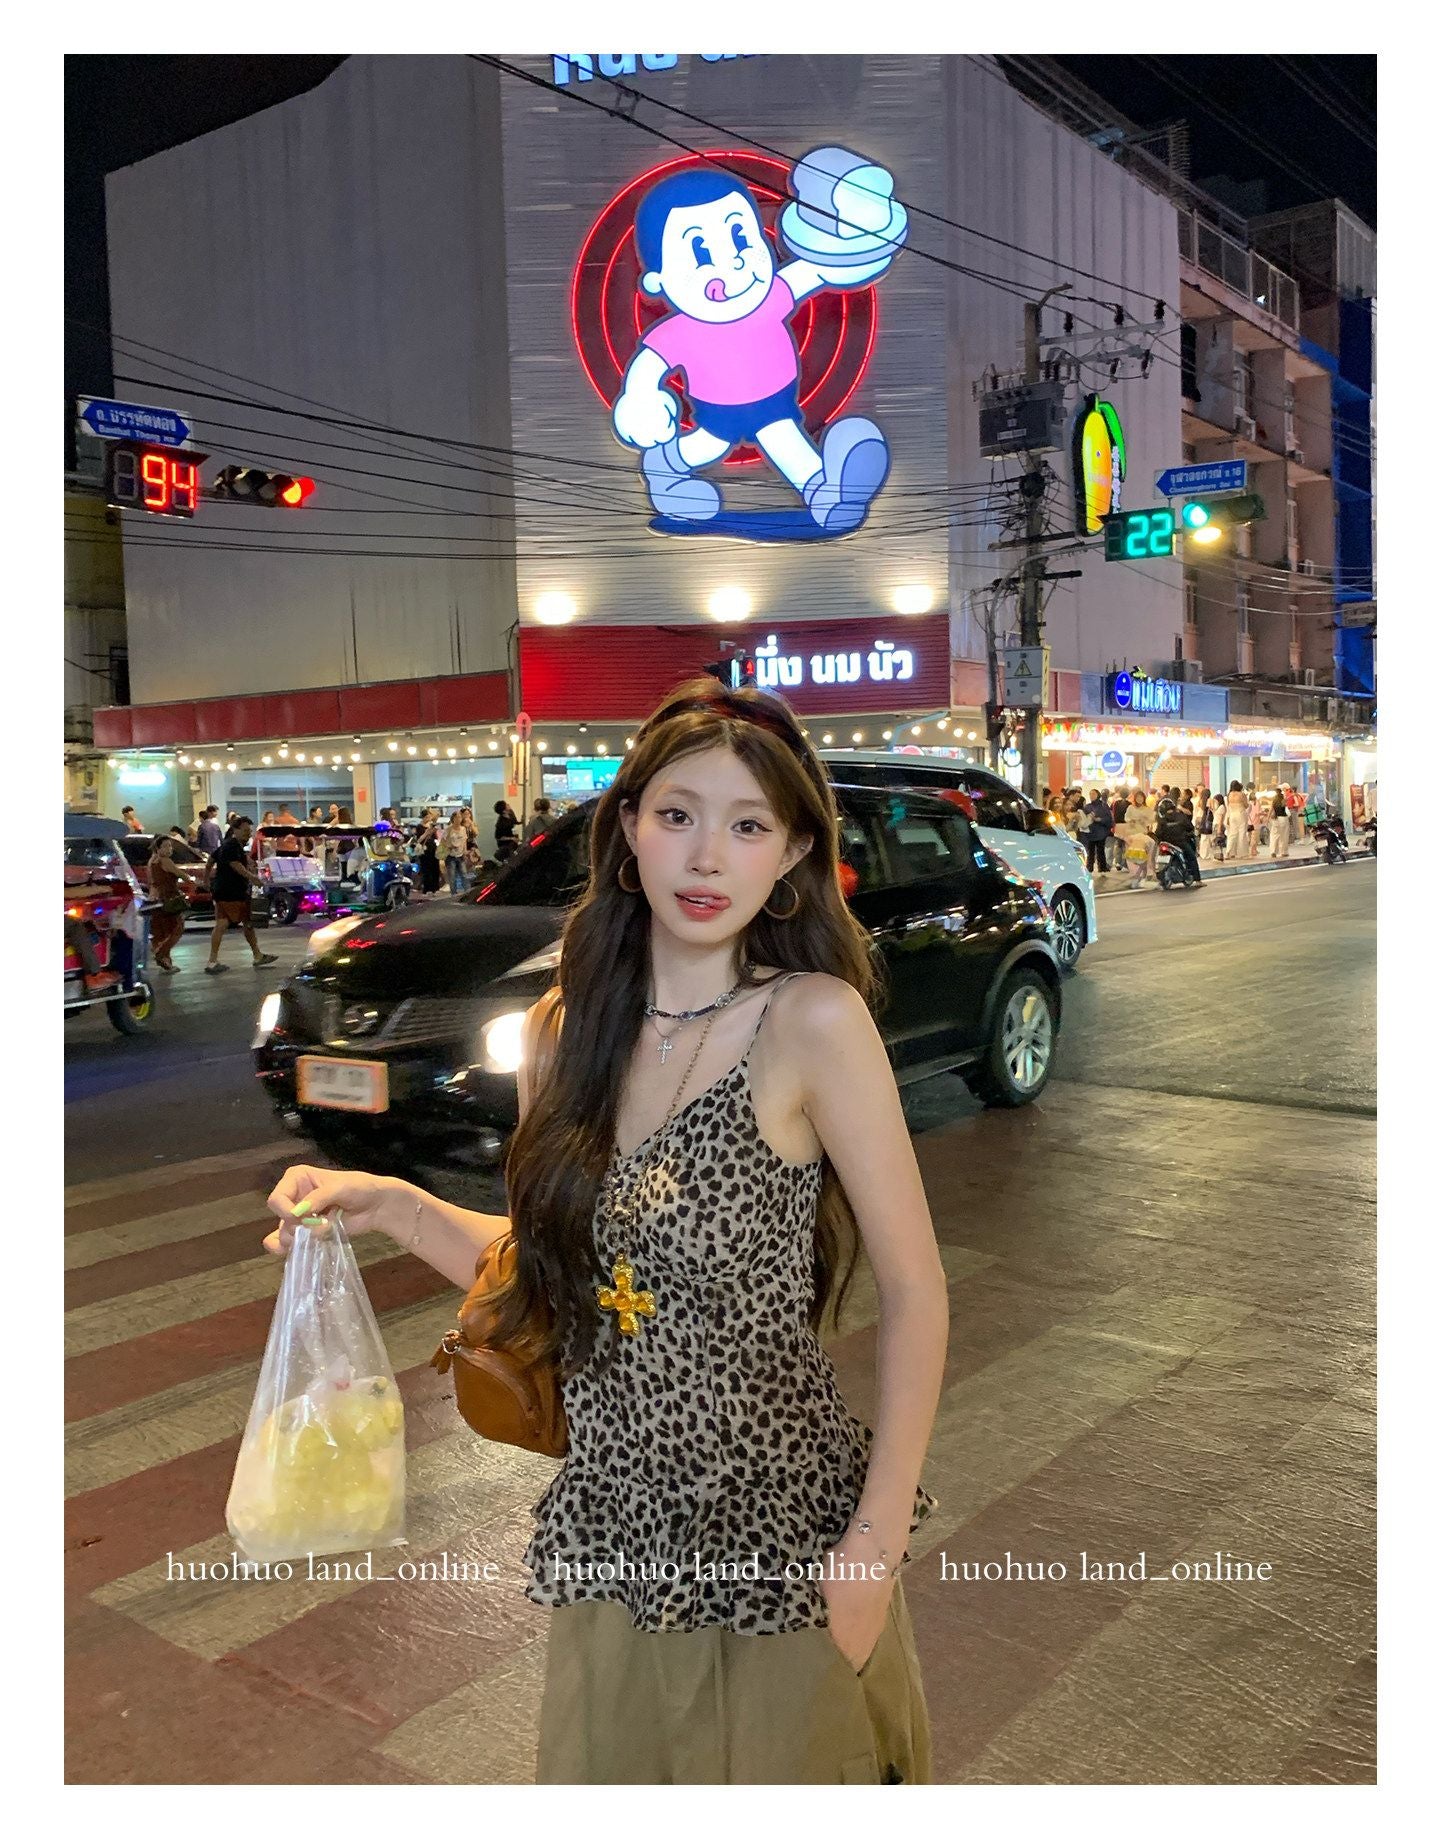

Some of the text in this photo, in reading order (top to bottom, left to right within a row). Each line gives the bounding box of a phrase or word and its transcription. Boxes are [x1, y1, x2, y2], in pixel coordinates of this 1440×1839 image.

[142, 454, 197, 510] 94
[1126, 512, 1173, 558] 22
[810, 652, 861, 684] นม
[867, 640, 914, 682] นัว
